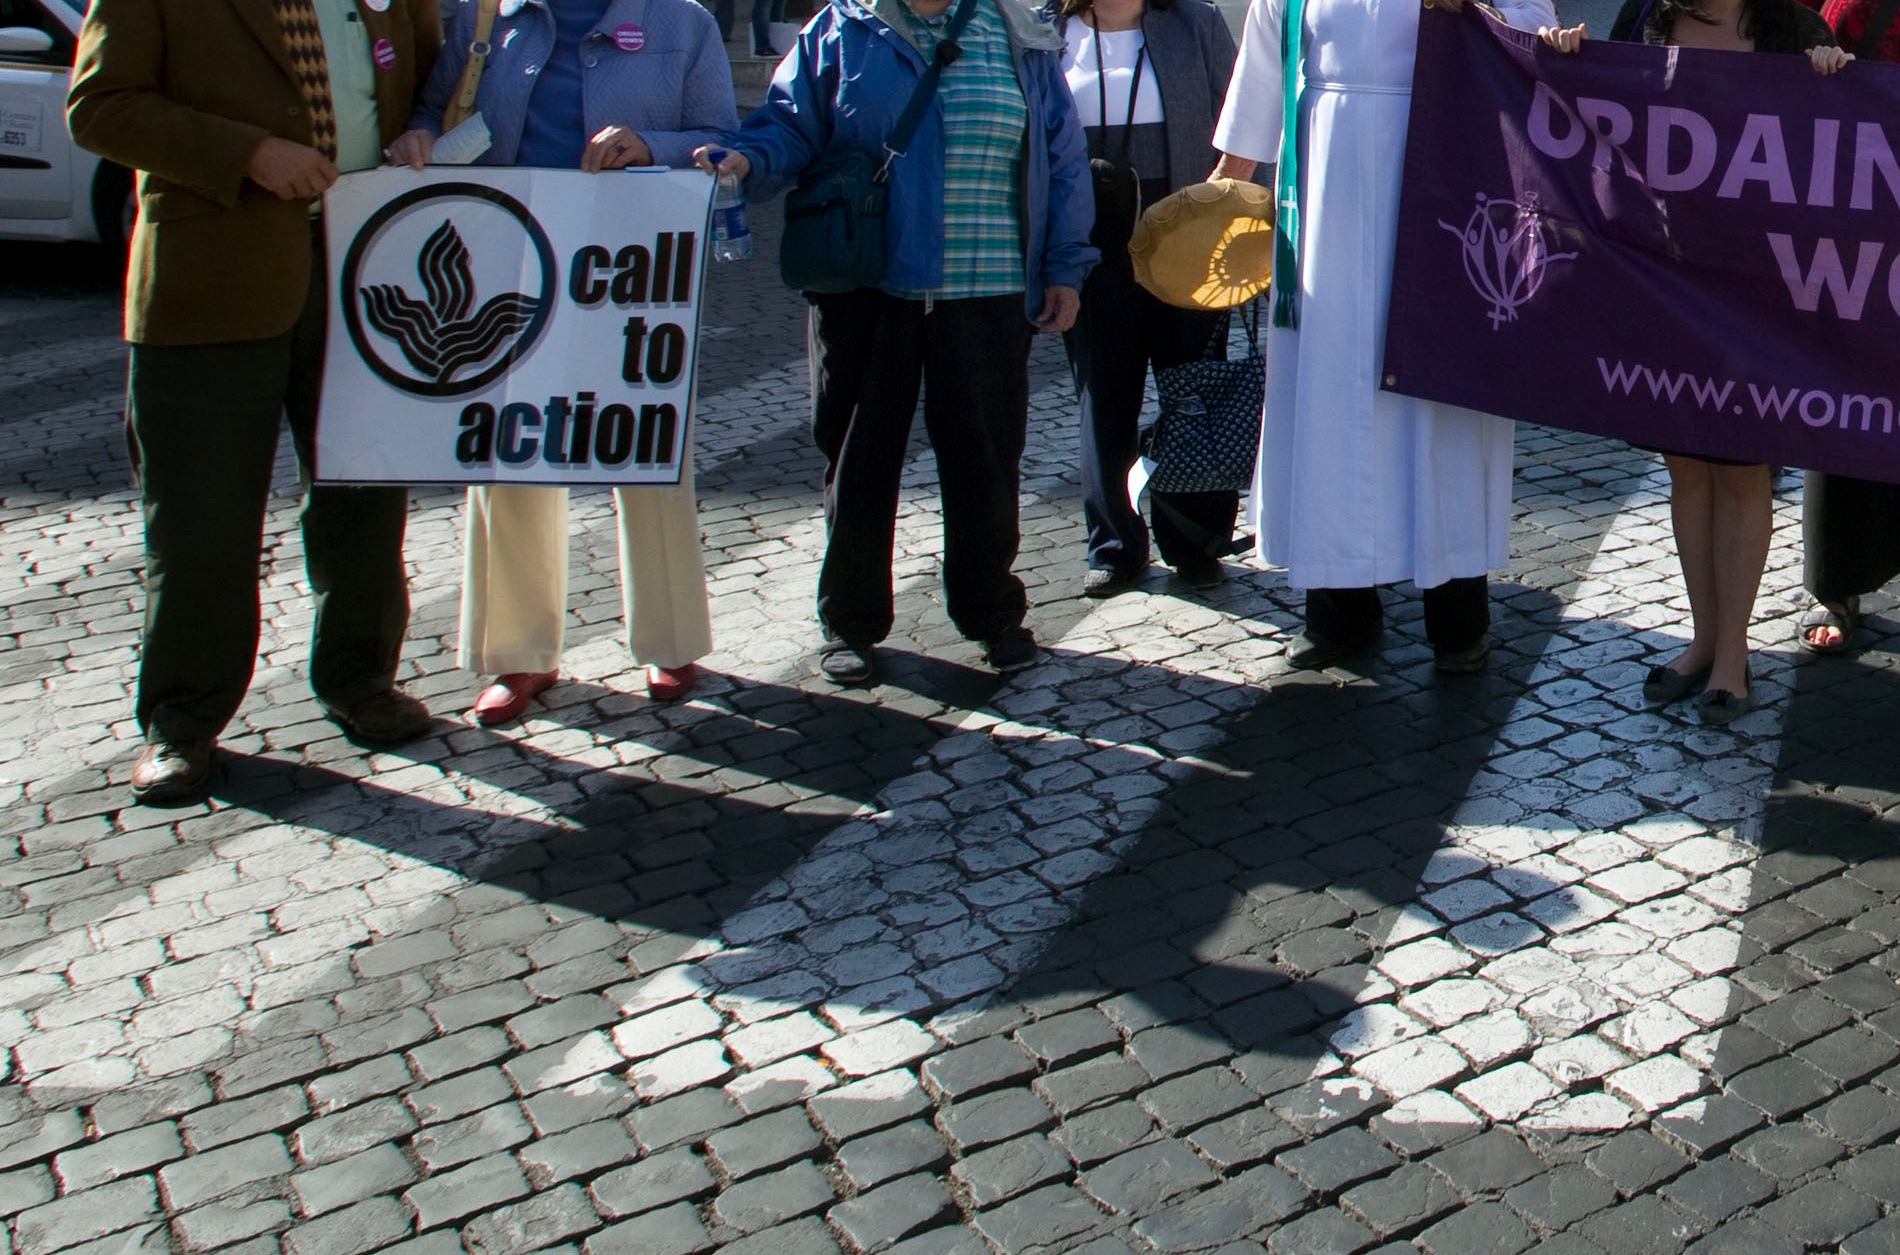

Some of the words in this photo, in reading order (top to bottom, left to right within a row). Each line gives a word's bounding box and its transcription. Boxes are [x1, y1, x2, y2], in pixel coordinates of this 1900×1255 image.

[569, 232, 696, 305] call
[622, 317, 686, 384] to
[456, 391, 678, 465] action
